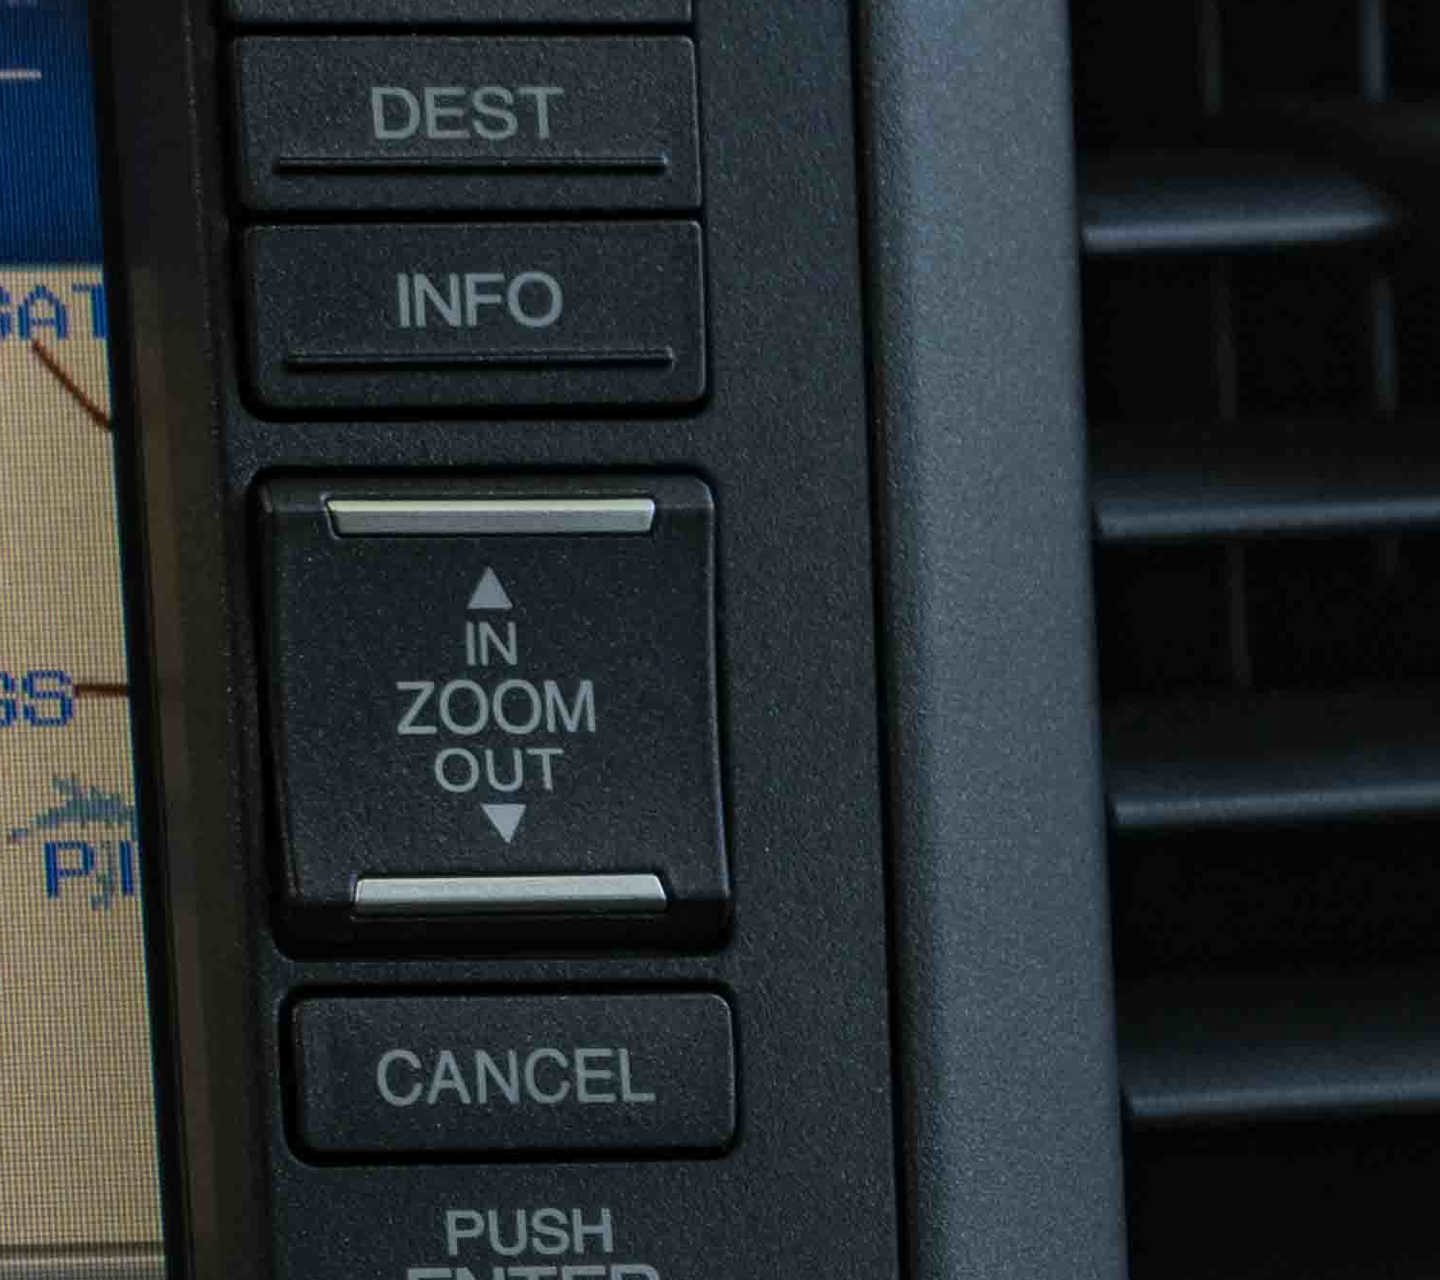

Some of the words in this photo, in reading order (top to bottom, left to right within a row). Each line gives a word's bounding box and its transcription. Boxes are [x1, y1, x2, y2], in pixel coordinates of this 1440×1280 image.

[370, 86, 565, 141] DEST
[395, 271, 565, 328] INFO
[466, 621, 518, 666] IN
[396, 679, 598, 736] ZOOM
[434, 747, 564, 793] OUT
[375, 1047, 657, 1107] CANCEL
[444, 1207, 615, 1256] PUSH
